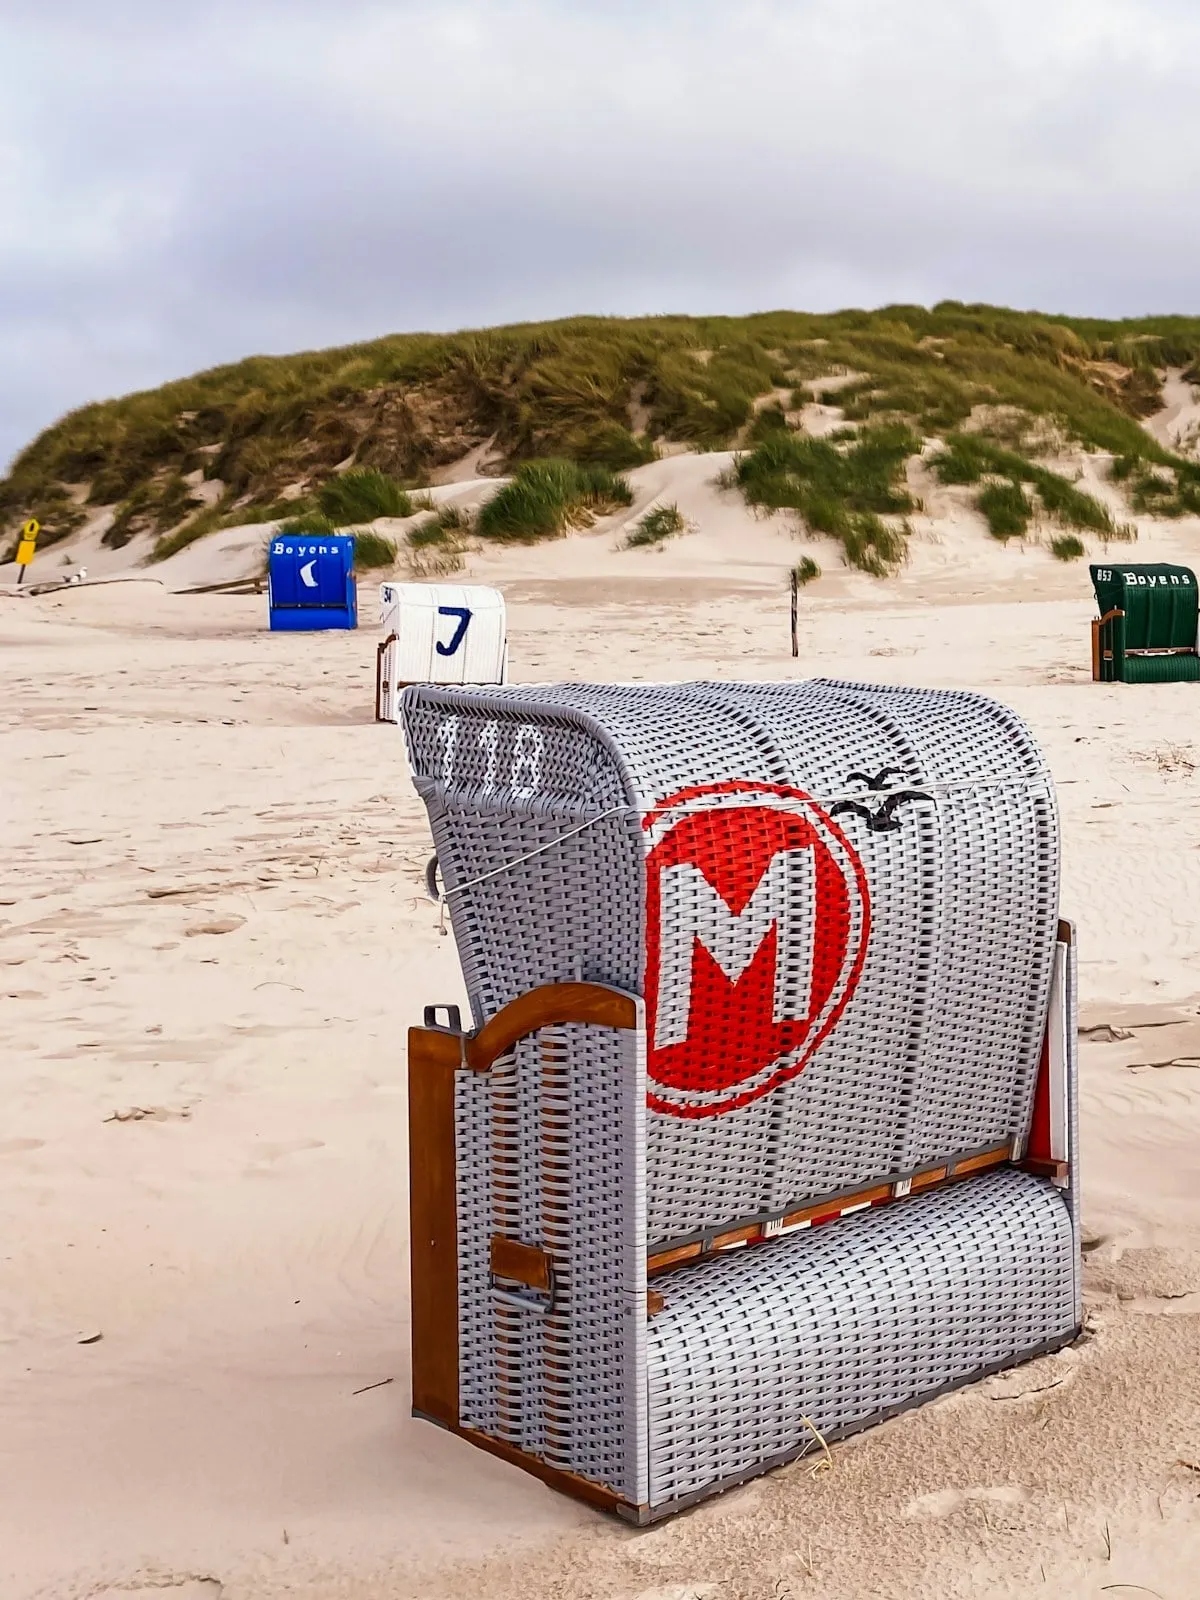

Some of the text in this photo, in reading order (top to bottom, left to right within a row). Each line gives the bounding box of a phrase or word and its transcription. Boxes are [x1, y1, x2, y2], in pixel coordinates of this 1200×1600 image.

[273, 542, 339, 557] Boyens
[1123, 572, 1190, 587] Boyens
[437, 714, 544, 800] 118
[653, 843, 816, 1052] M
